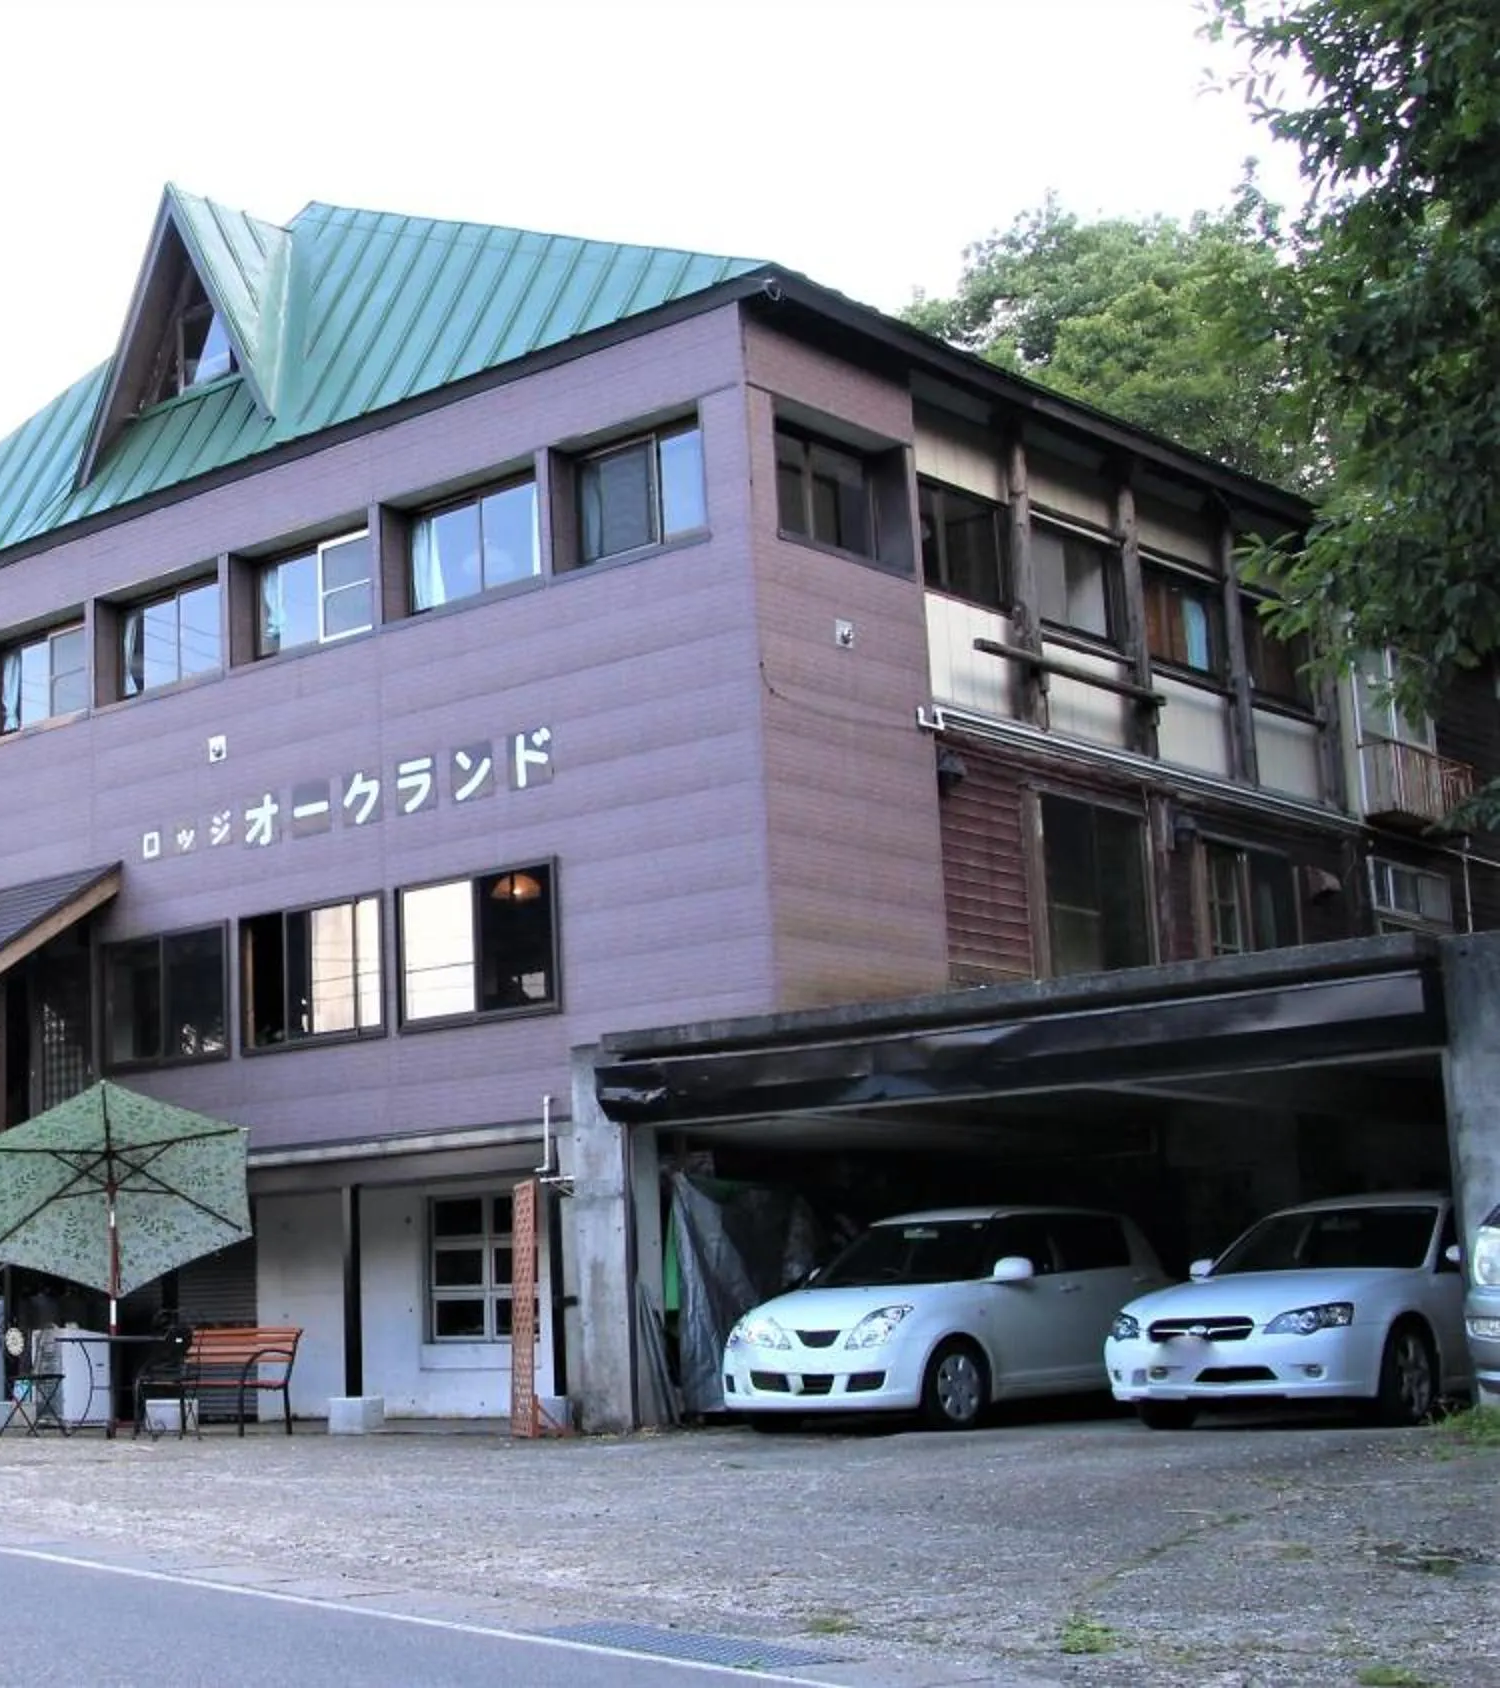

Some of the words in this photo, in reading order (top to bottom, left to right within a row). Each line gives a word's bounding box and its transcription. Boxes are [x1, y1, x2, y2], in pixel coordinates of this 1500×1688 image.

[142, 810, 231, 860] ロッジ
[244, 727, 552, 845] オークランド
